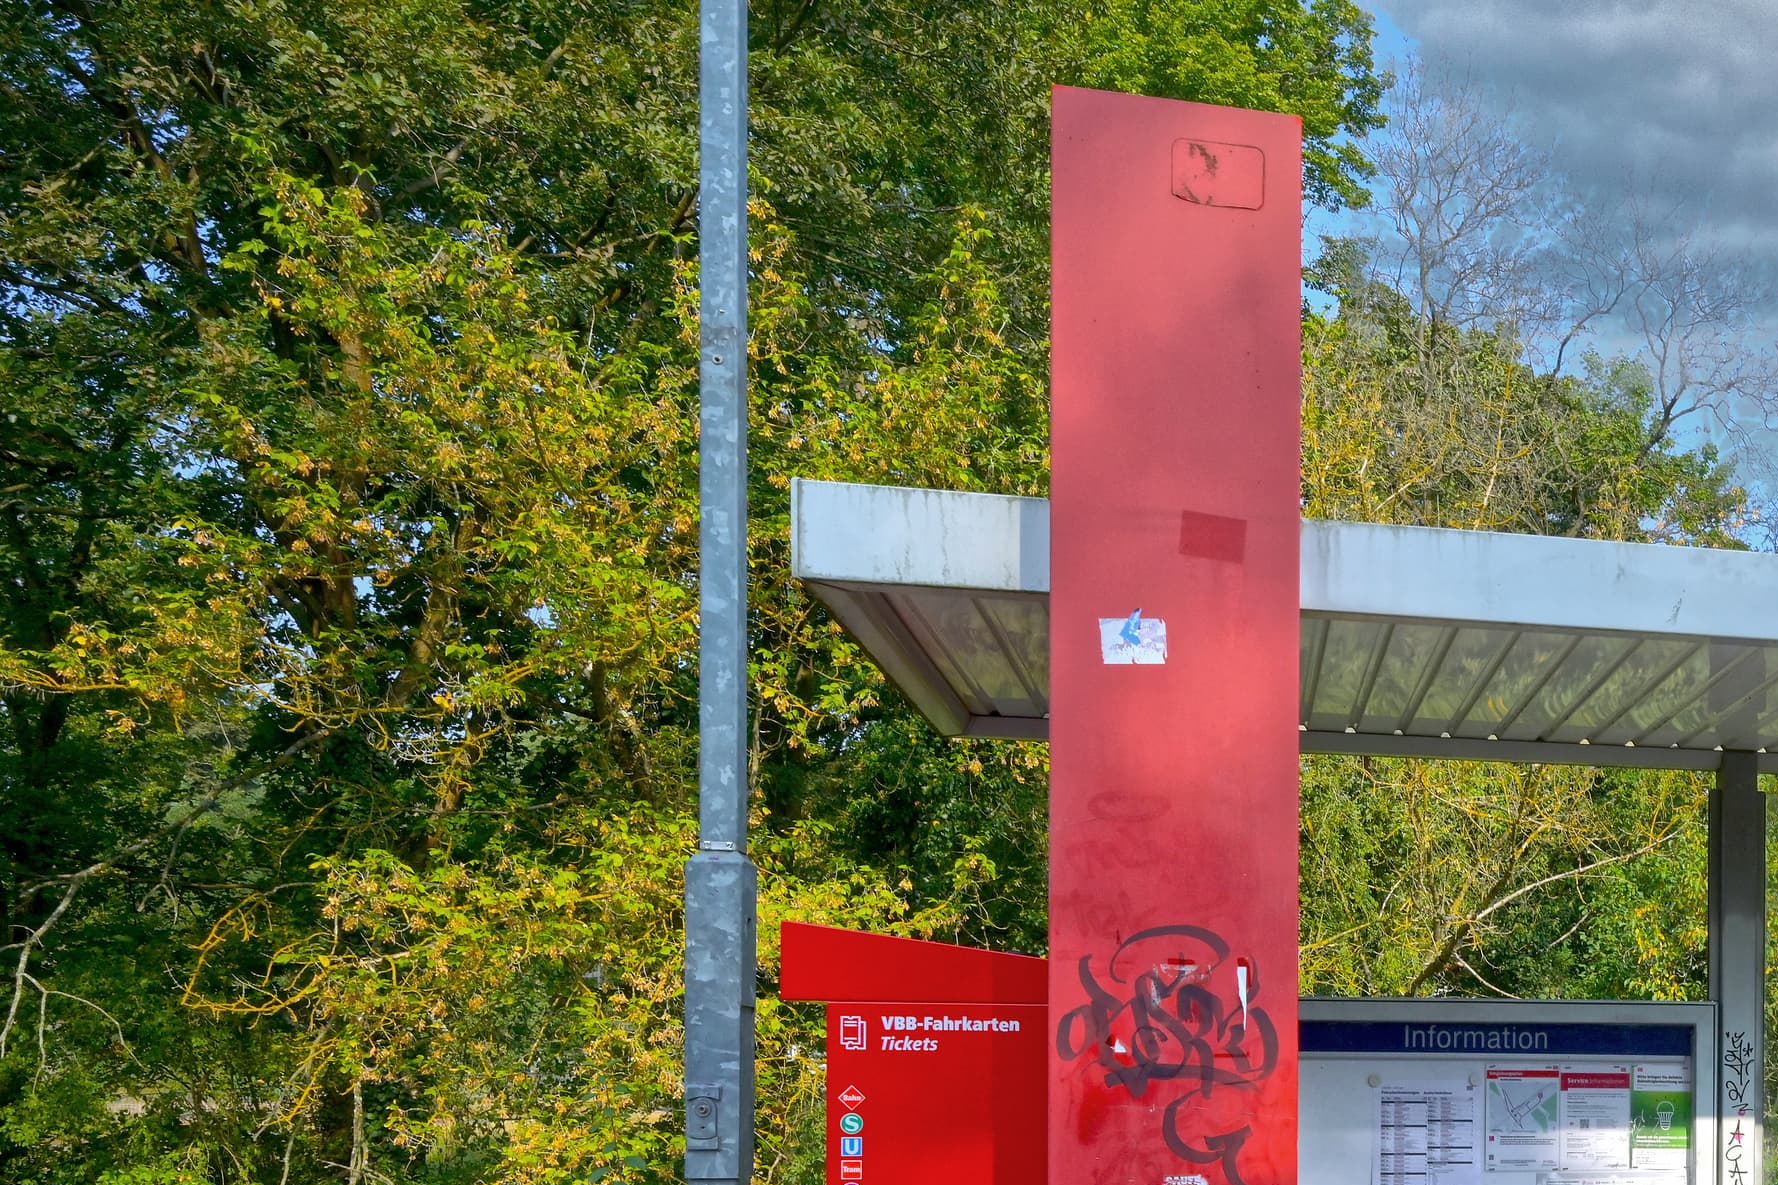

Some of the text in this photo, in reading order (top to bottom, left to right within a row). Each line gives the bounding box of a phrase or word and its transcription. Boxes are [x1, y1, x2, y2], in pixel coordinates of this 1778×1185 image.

[881, 1015, 1020, 1032] VBB-Fahrkarten
[880, 1036, 938, 1051] Tickets
[1404, 1024, 1548, 1049] Information
[844, 1115, 860, 1132] S
[844, 1139, 859, 1154] U
